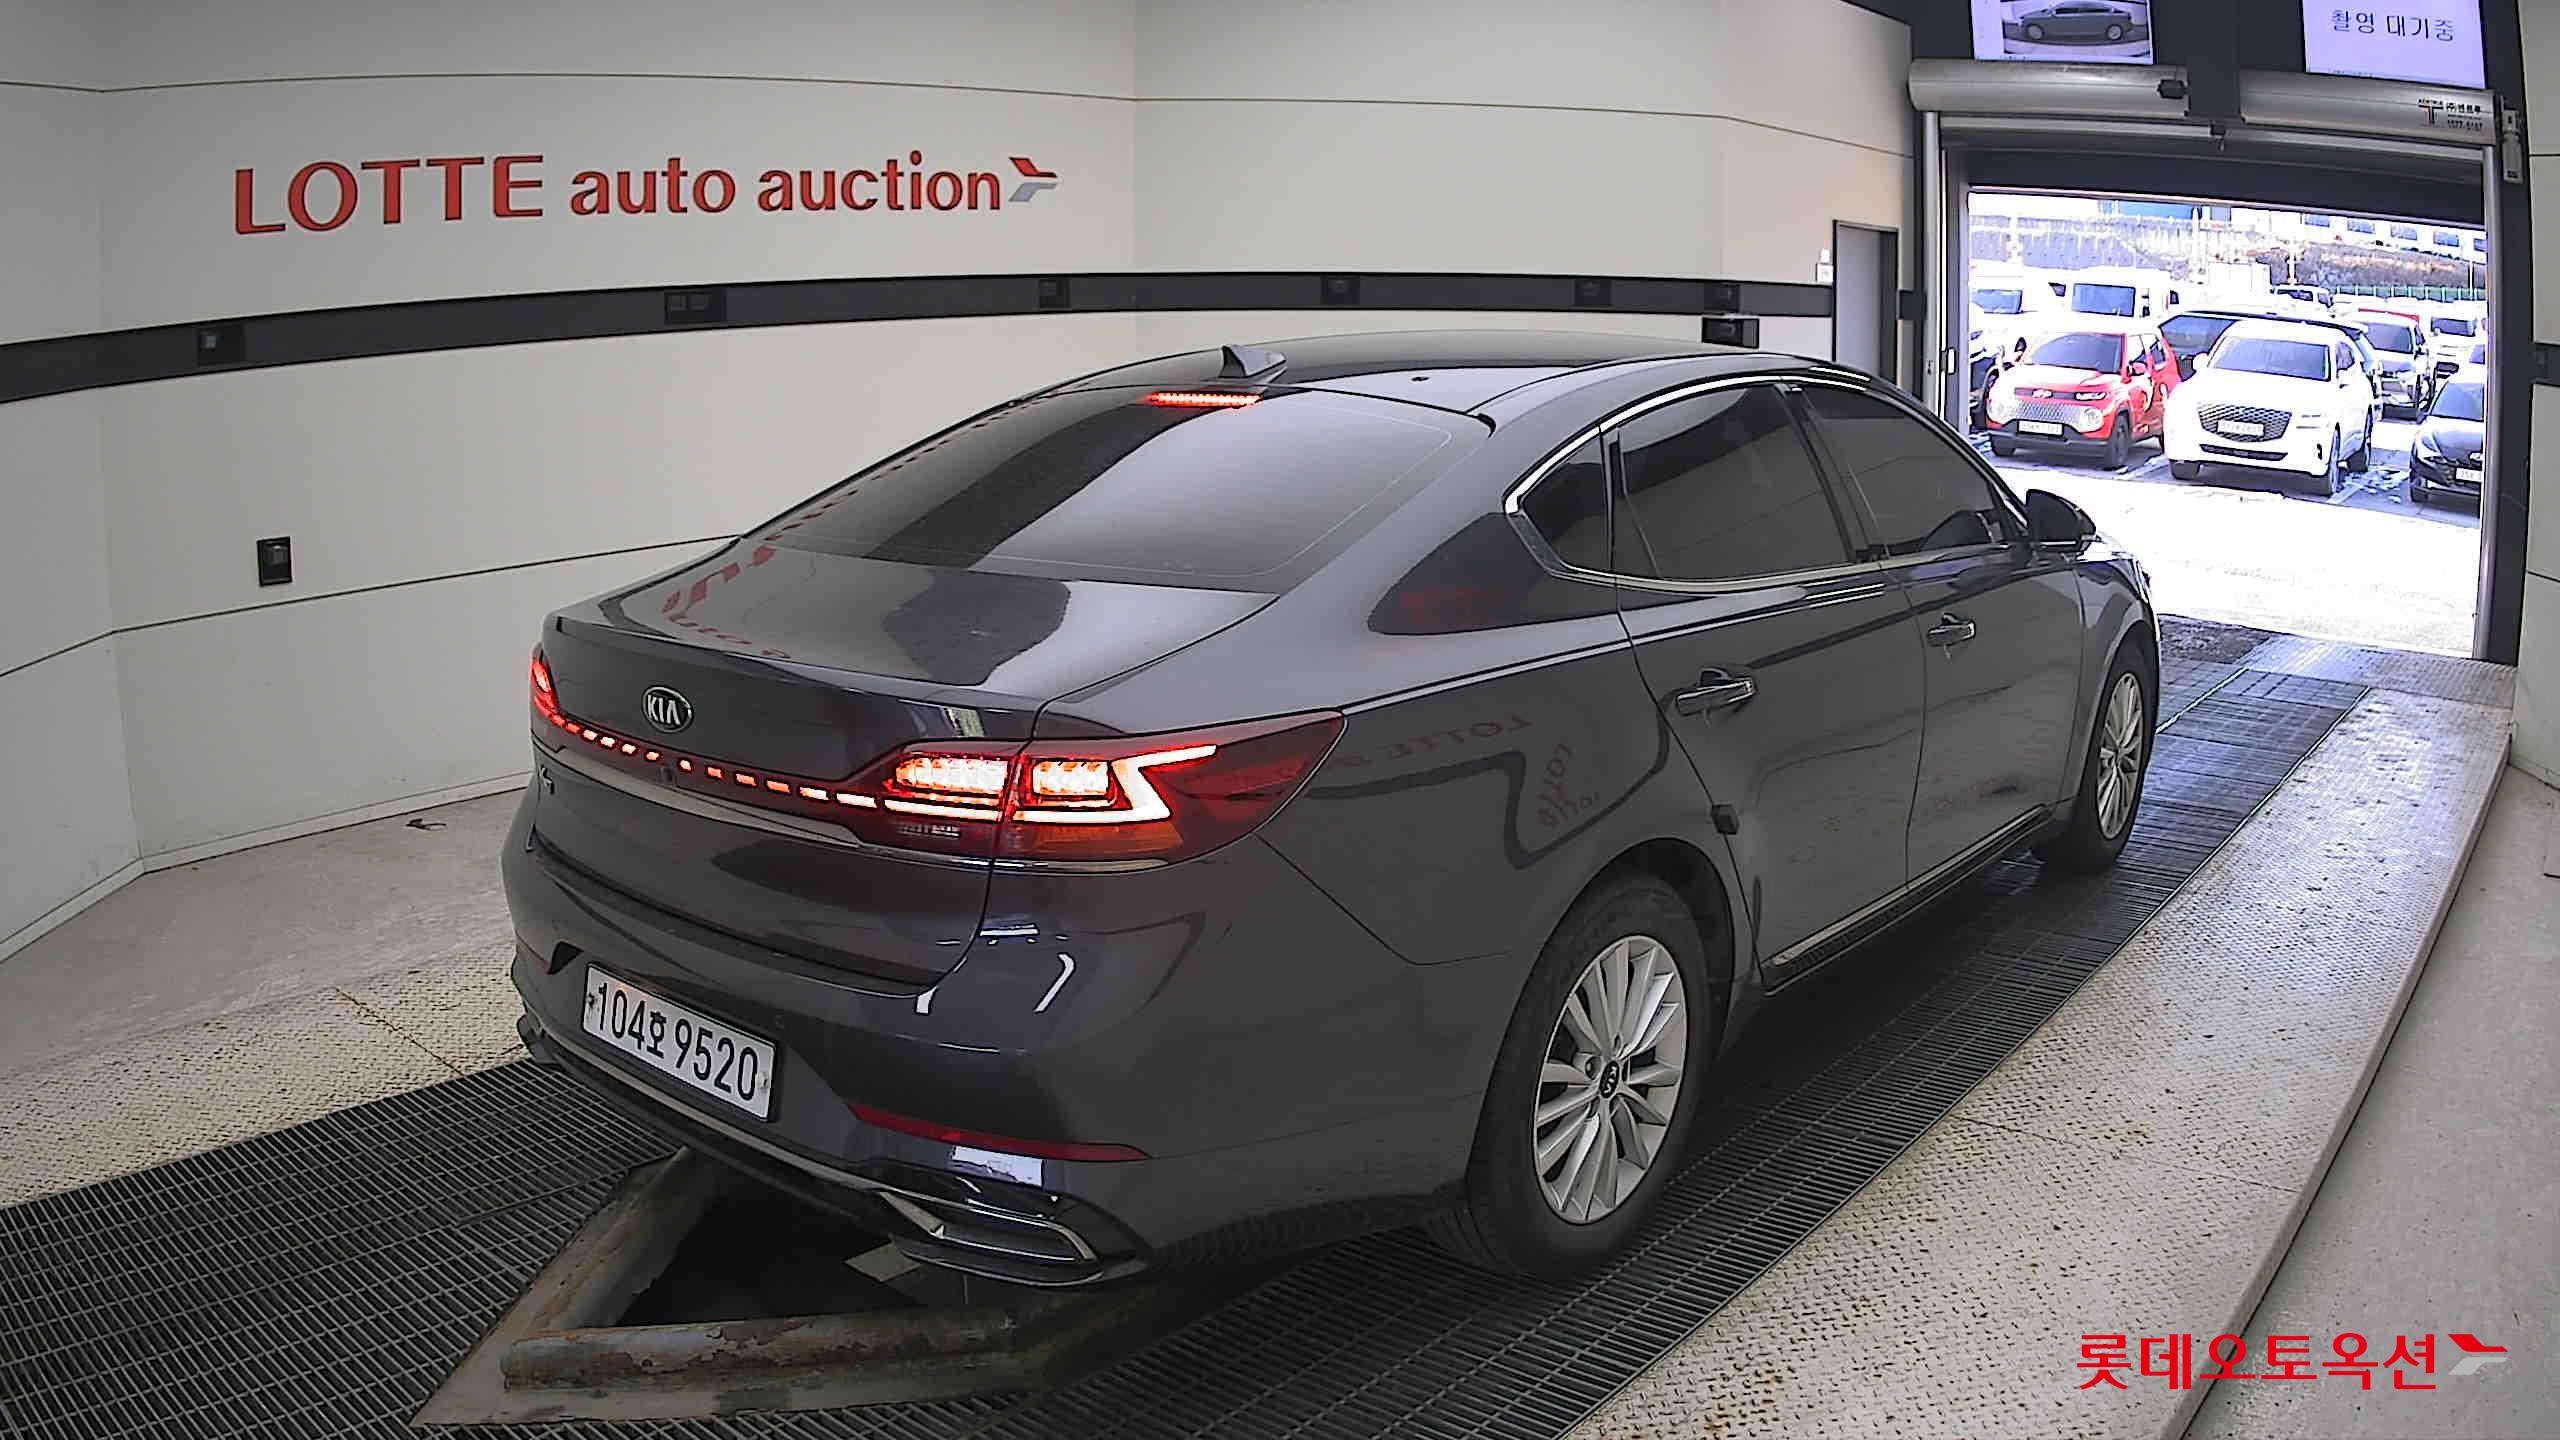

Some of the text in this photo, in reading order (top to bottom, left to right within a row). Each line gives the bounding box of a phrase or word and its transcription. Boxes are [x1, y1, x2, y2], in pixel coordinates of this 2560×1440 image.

[2333, 11, 2453, 41] 촬영 대기중
[236, 151, 1001, 234] LOTTE auto auction
[647, 694, 681, 726] KIA
[598, 982, 758, 1101] 104호 9520
